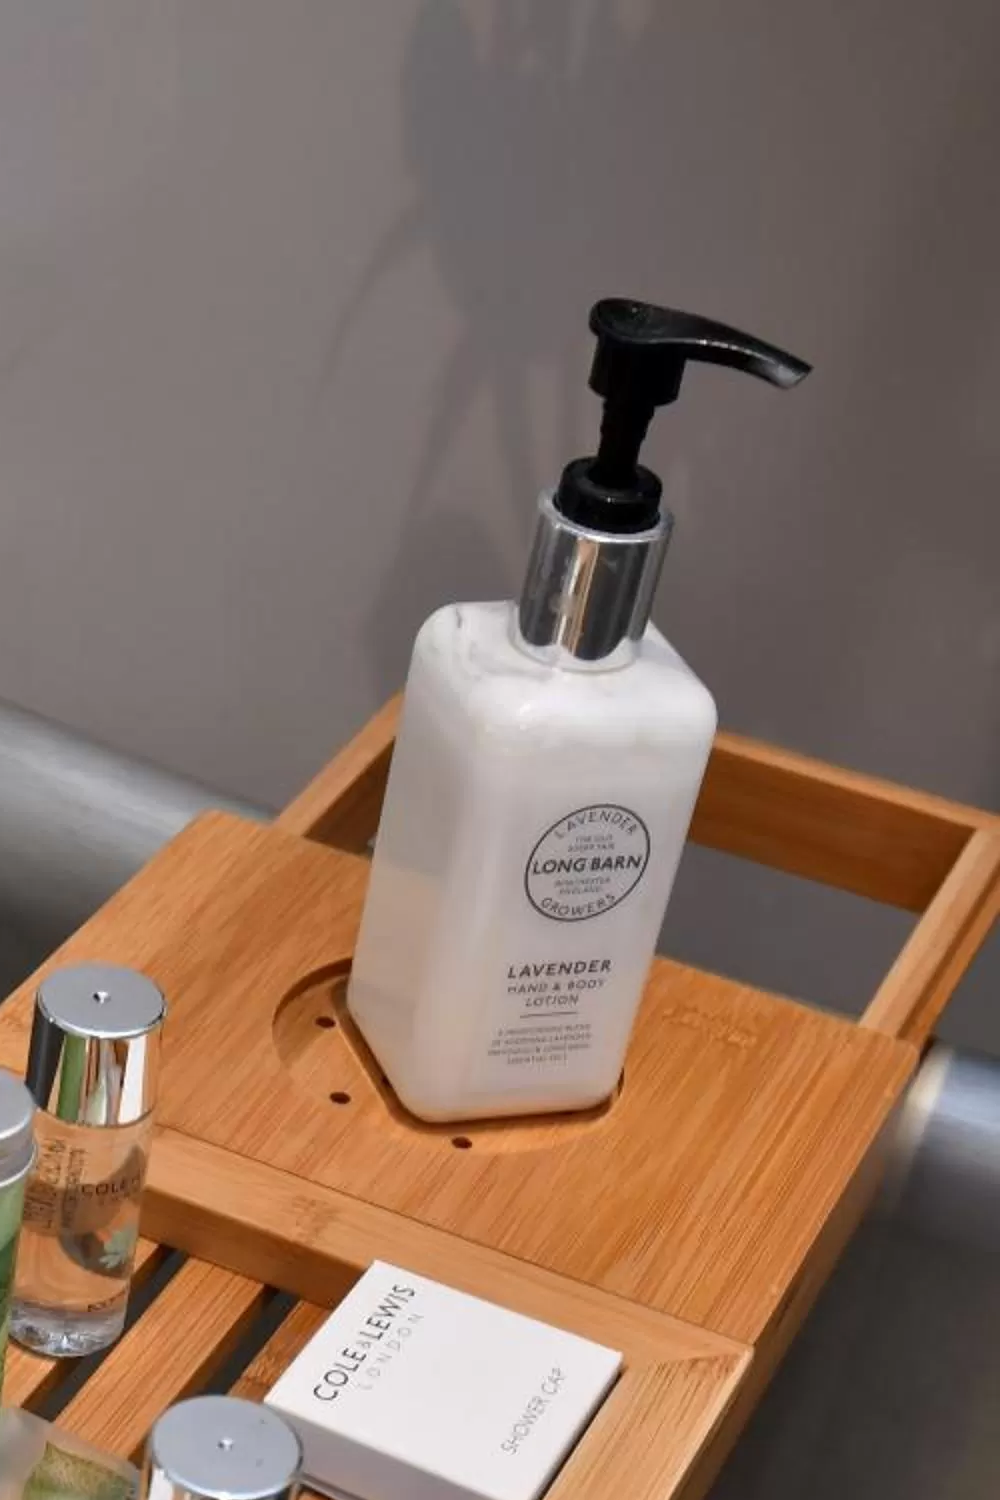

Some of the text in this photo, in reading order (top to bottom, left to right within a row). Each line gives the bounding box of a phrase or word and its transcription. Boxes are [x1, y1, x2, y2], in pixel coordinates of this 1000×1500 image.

[553, 810, 638, 839] LAVENDER
[532, 855, 643, 875] LONG BARN
[541, 894, 616, 916] GROWERS
[507, 959, 612, 979] LAVENDER
[507, 983, 549, 994] HAND
[525, 994, 579, 1007] LOTION
[313, 1347, 367, 1401] COLE
[358, 1284, 416, 1341] LEWIS
[500, 1395, 550, 1455] SHOWER
